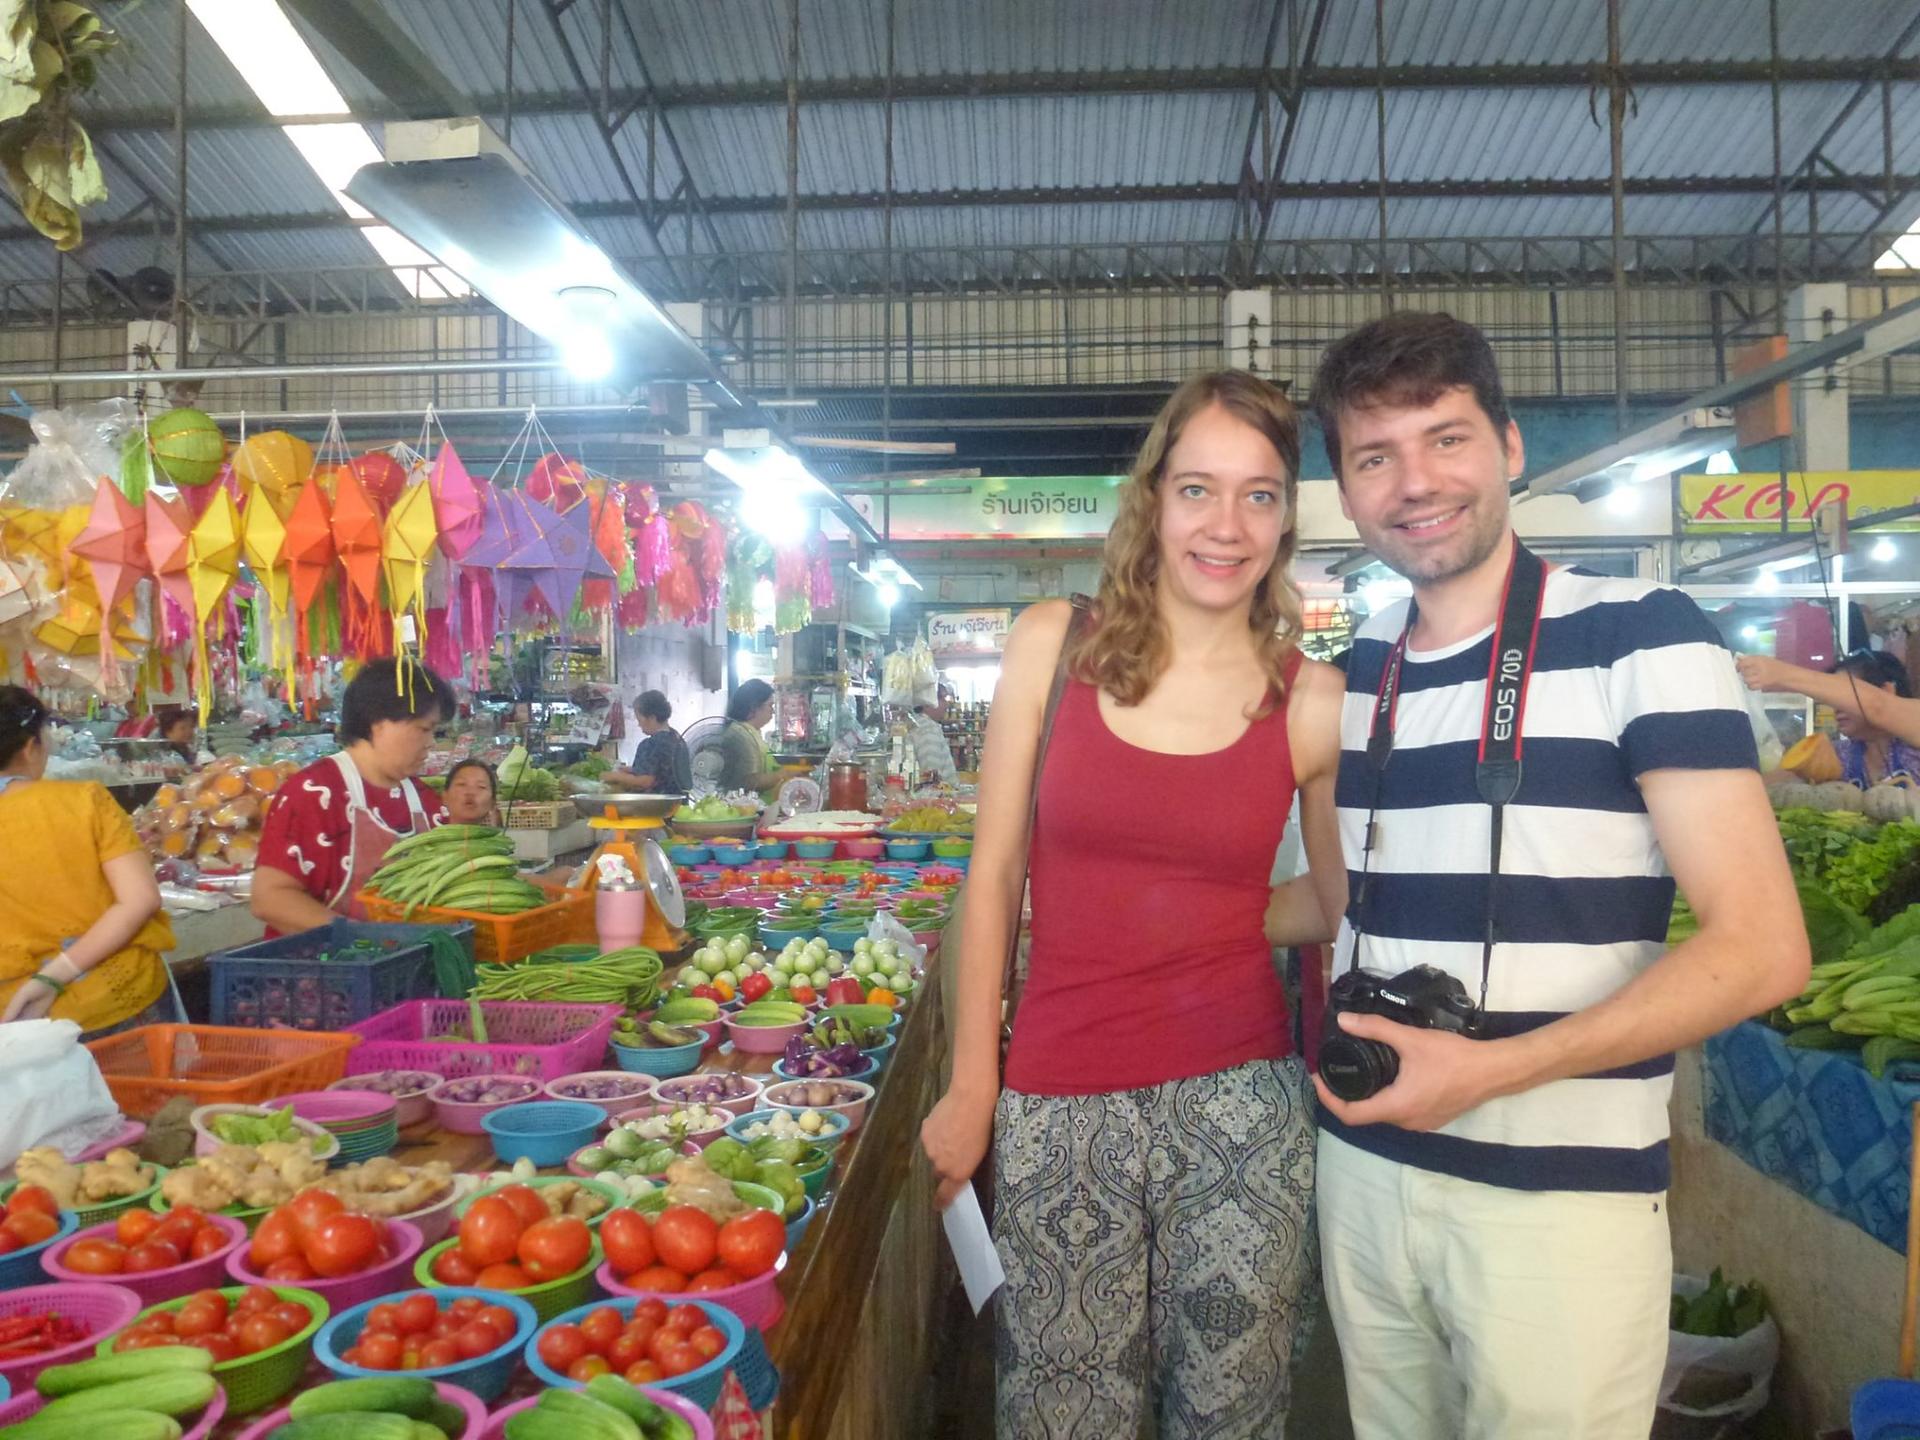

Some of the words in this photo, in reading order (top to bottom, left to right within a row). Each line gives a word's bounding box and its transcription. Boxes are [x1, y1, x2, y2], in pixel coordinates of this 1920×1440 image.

[982, 491, 1098, 514] ร้านเจ๊เวียน
[1500, 648, 1522, 683] 70D
[1493, 688, 1516, 741] EOS
[1380, 989, 1406, 1006] Canon
